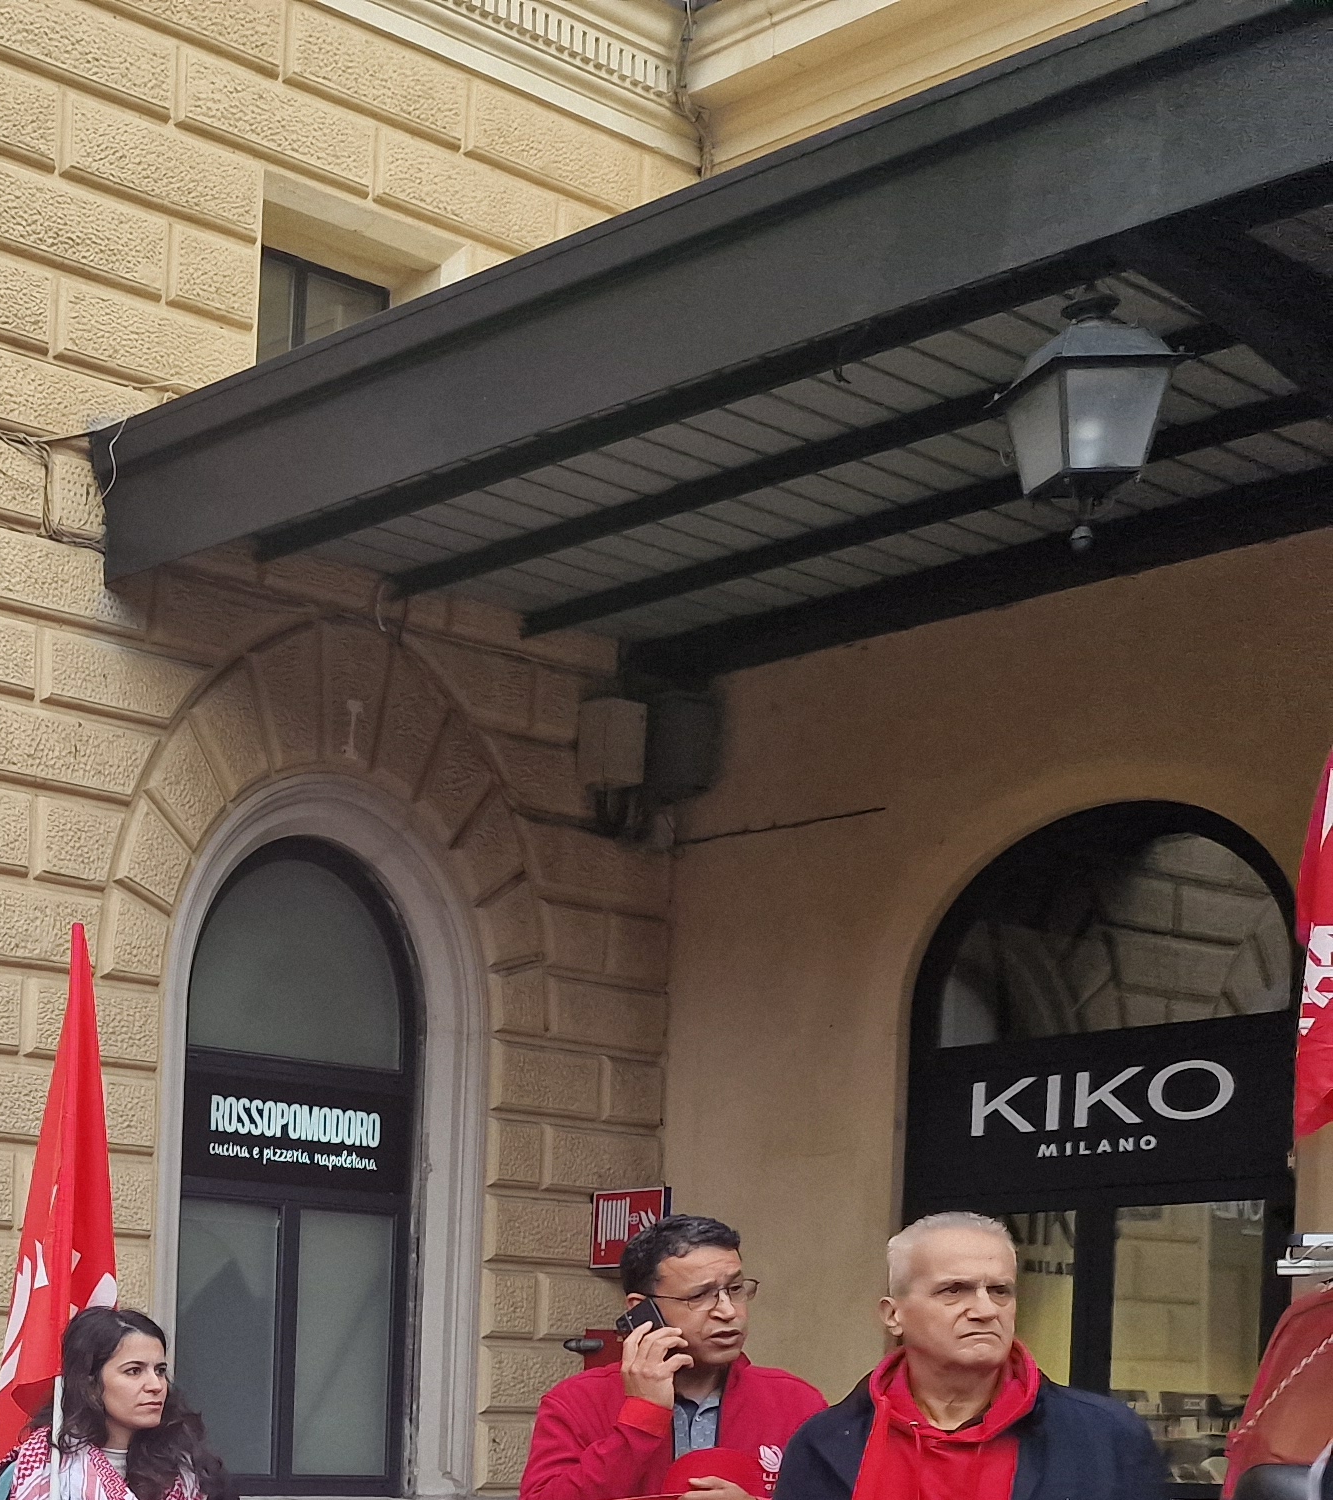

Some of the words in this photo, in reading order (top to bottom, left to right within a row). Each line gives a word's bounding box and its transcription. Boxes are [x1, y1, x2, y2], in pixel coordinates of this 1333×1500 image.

[969, 1059, 1236, 1137] KIKO
[210, 1094, 381, 1149] ROSSOPOMODORO
[209, 1142, 250, 1159] cucina
[252, 1147, 261, 1159] e
[263, 1145, 311, 1165] pizzeria
[314, 1150, 378, 1171] napoletana
[1036, 1134, 1159, 1159] MILANO
